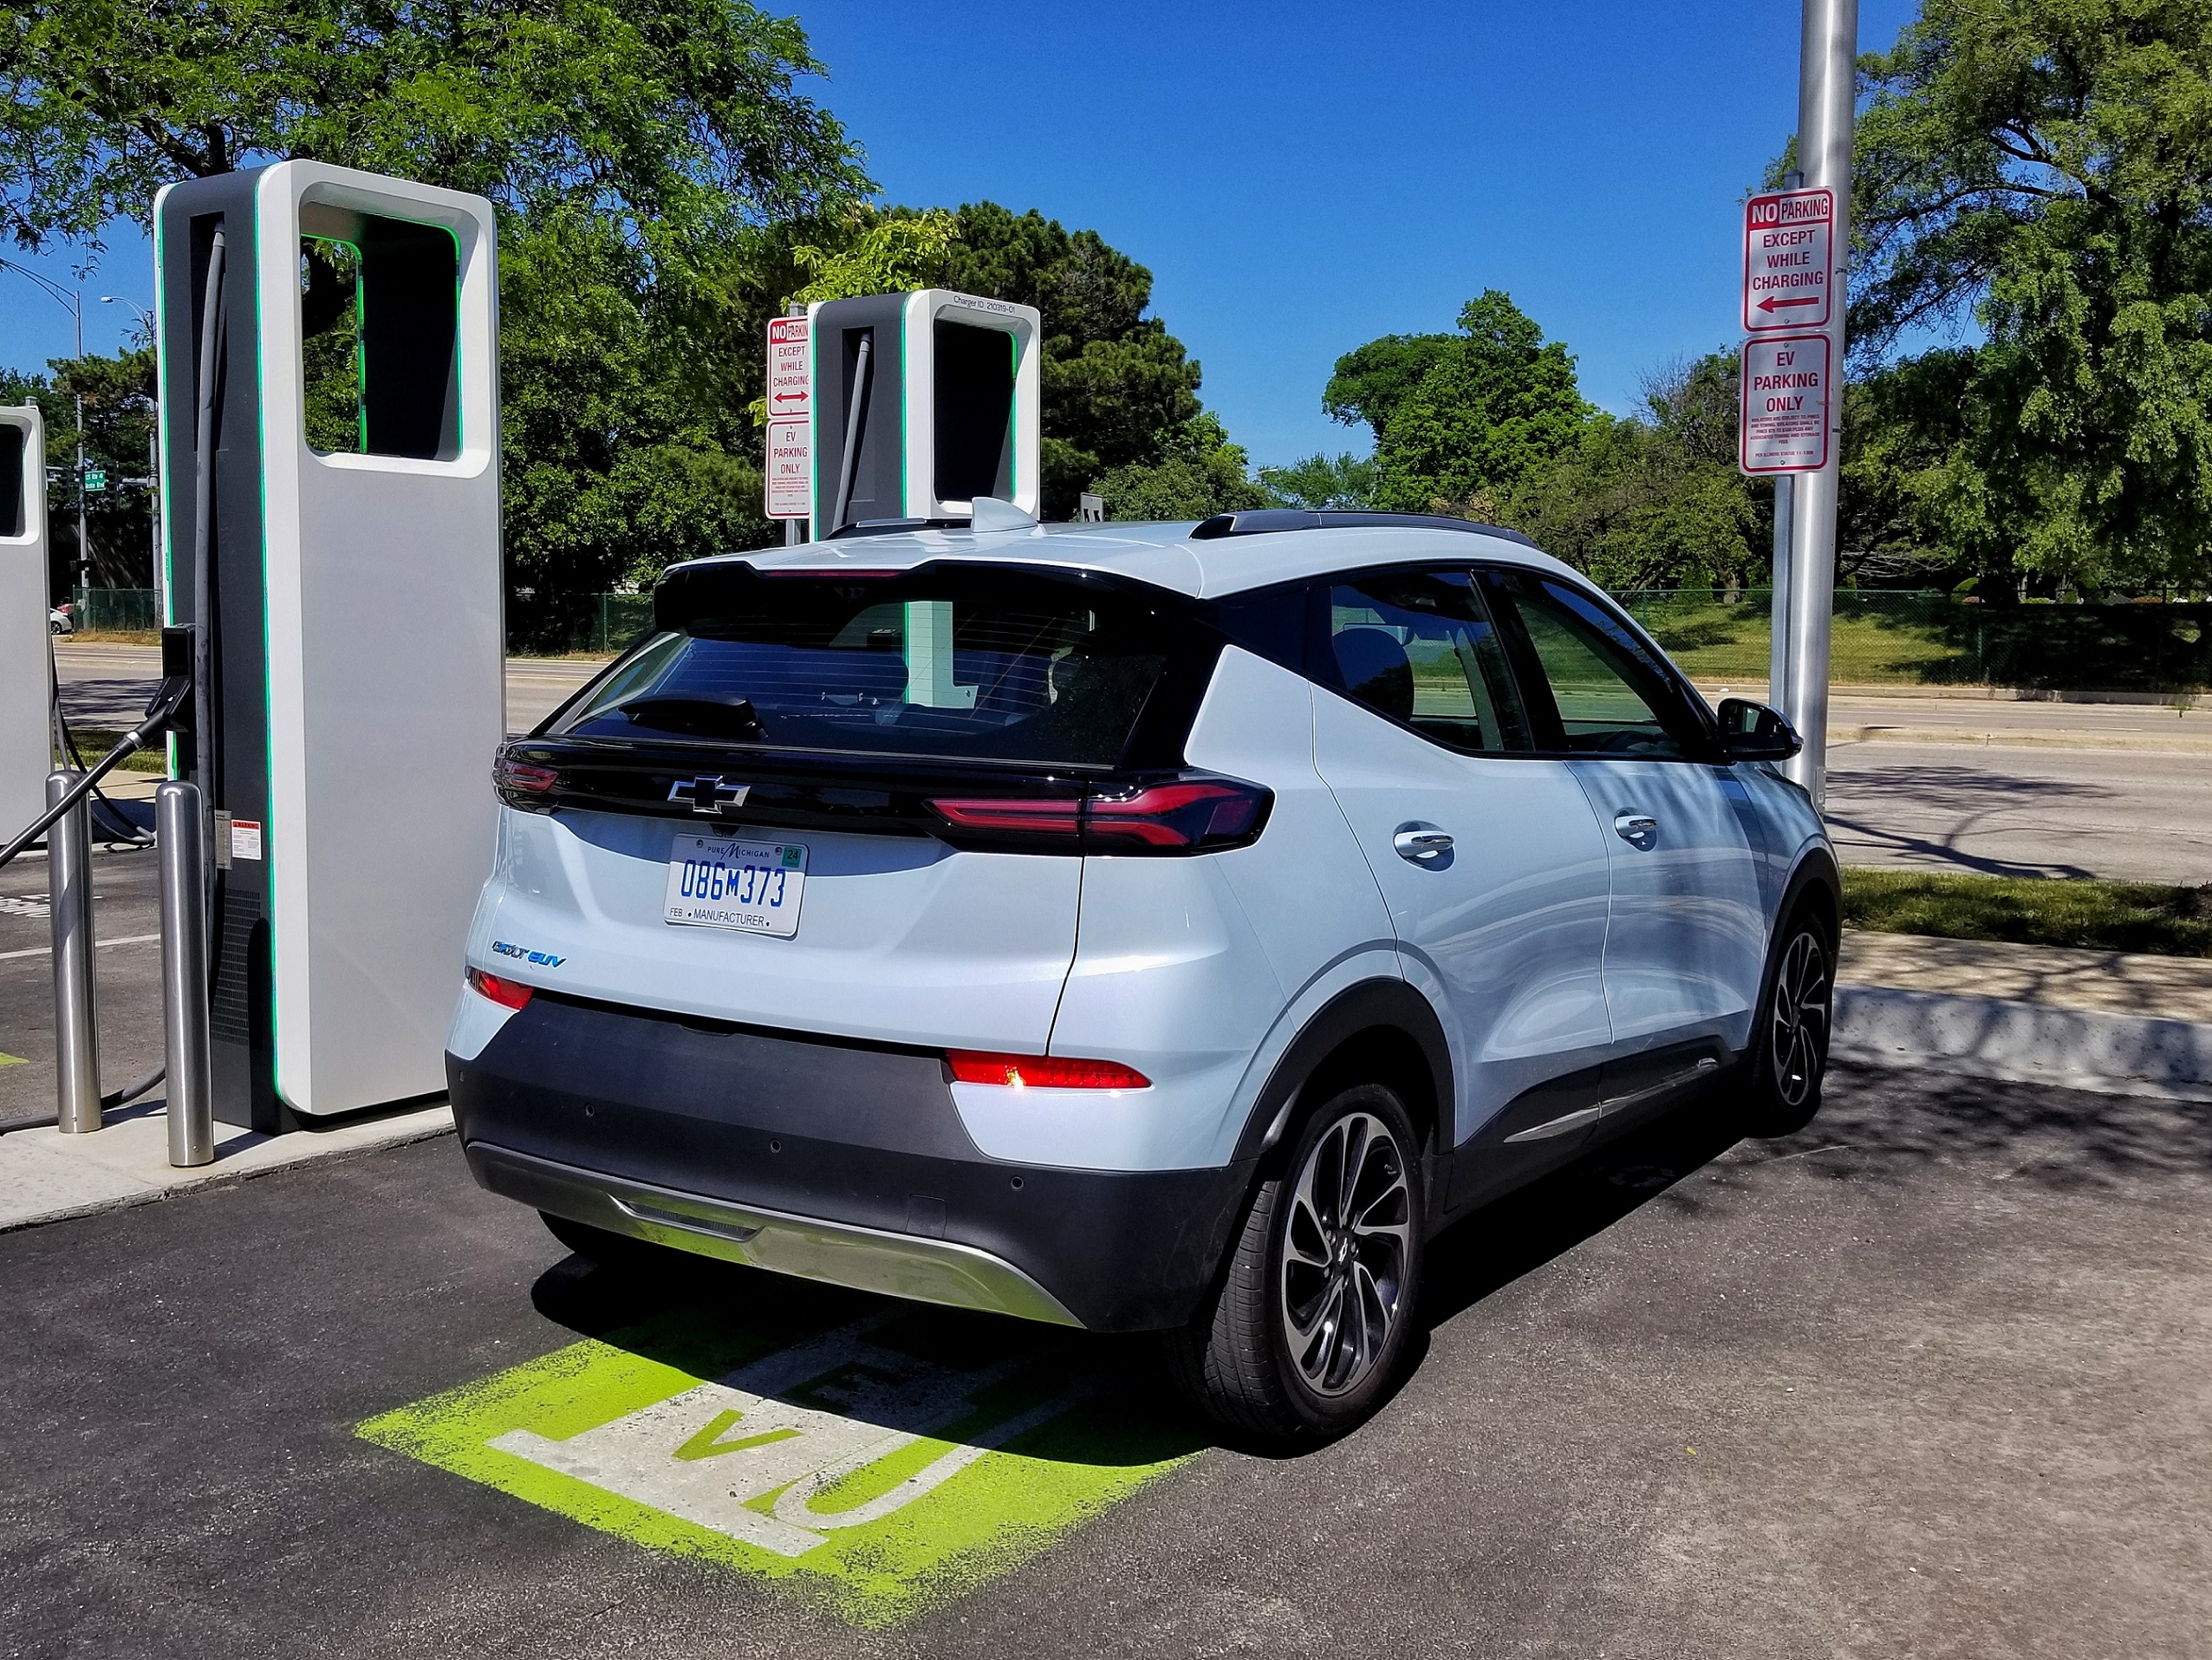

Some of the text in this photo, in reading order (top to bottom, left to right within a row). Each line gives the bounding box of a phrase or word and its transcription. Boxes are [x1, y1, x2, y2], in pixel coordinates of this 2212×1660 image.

[1752, 198, 1828, 224] NO PARKING
[1763, 229, 1816, 248] EXCEPT
[1766, 251, 1811, 269] WHILE
[1753, 270, 1824, 290] CHARGING
[953, 295, 977, 308] Charger
[977, 300, 985, 309] ID
[772, 323, 808, 340] NO PARKIN
[778, 345, 806, 357] EXCEPT
[1777, 351, 1795, 367] EV
[780, 361, 803, 372] WHILE
[773, 374, 809, 387] CHARGING
[1753, 372, 1818, 390] PARKING
[1766, 395, 1804, 413] ONLY
[786, 432, 796, 442] EV
[774, 446, 808, 459] PARKING
[781, 464, 800, 474] ONLY
[707, 843, 770, 859] PURE MICHIGAN
[787, 849, 798, 861] 24
[681, 859, 786, 908] 086M373
[669, 908, 764, 927] FEB MANUFACTURER
[528, 950, 567, 968] EUV
